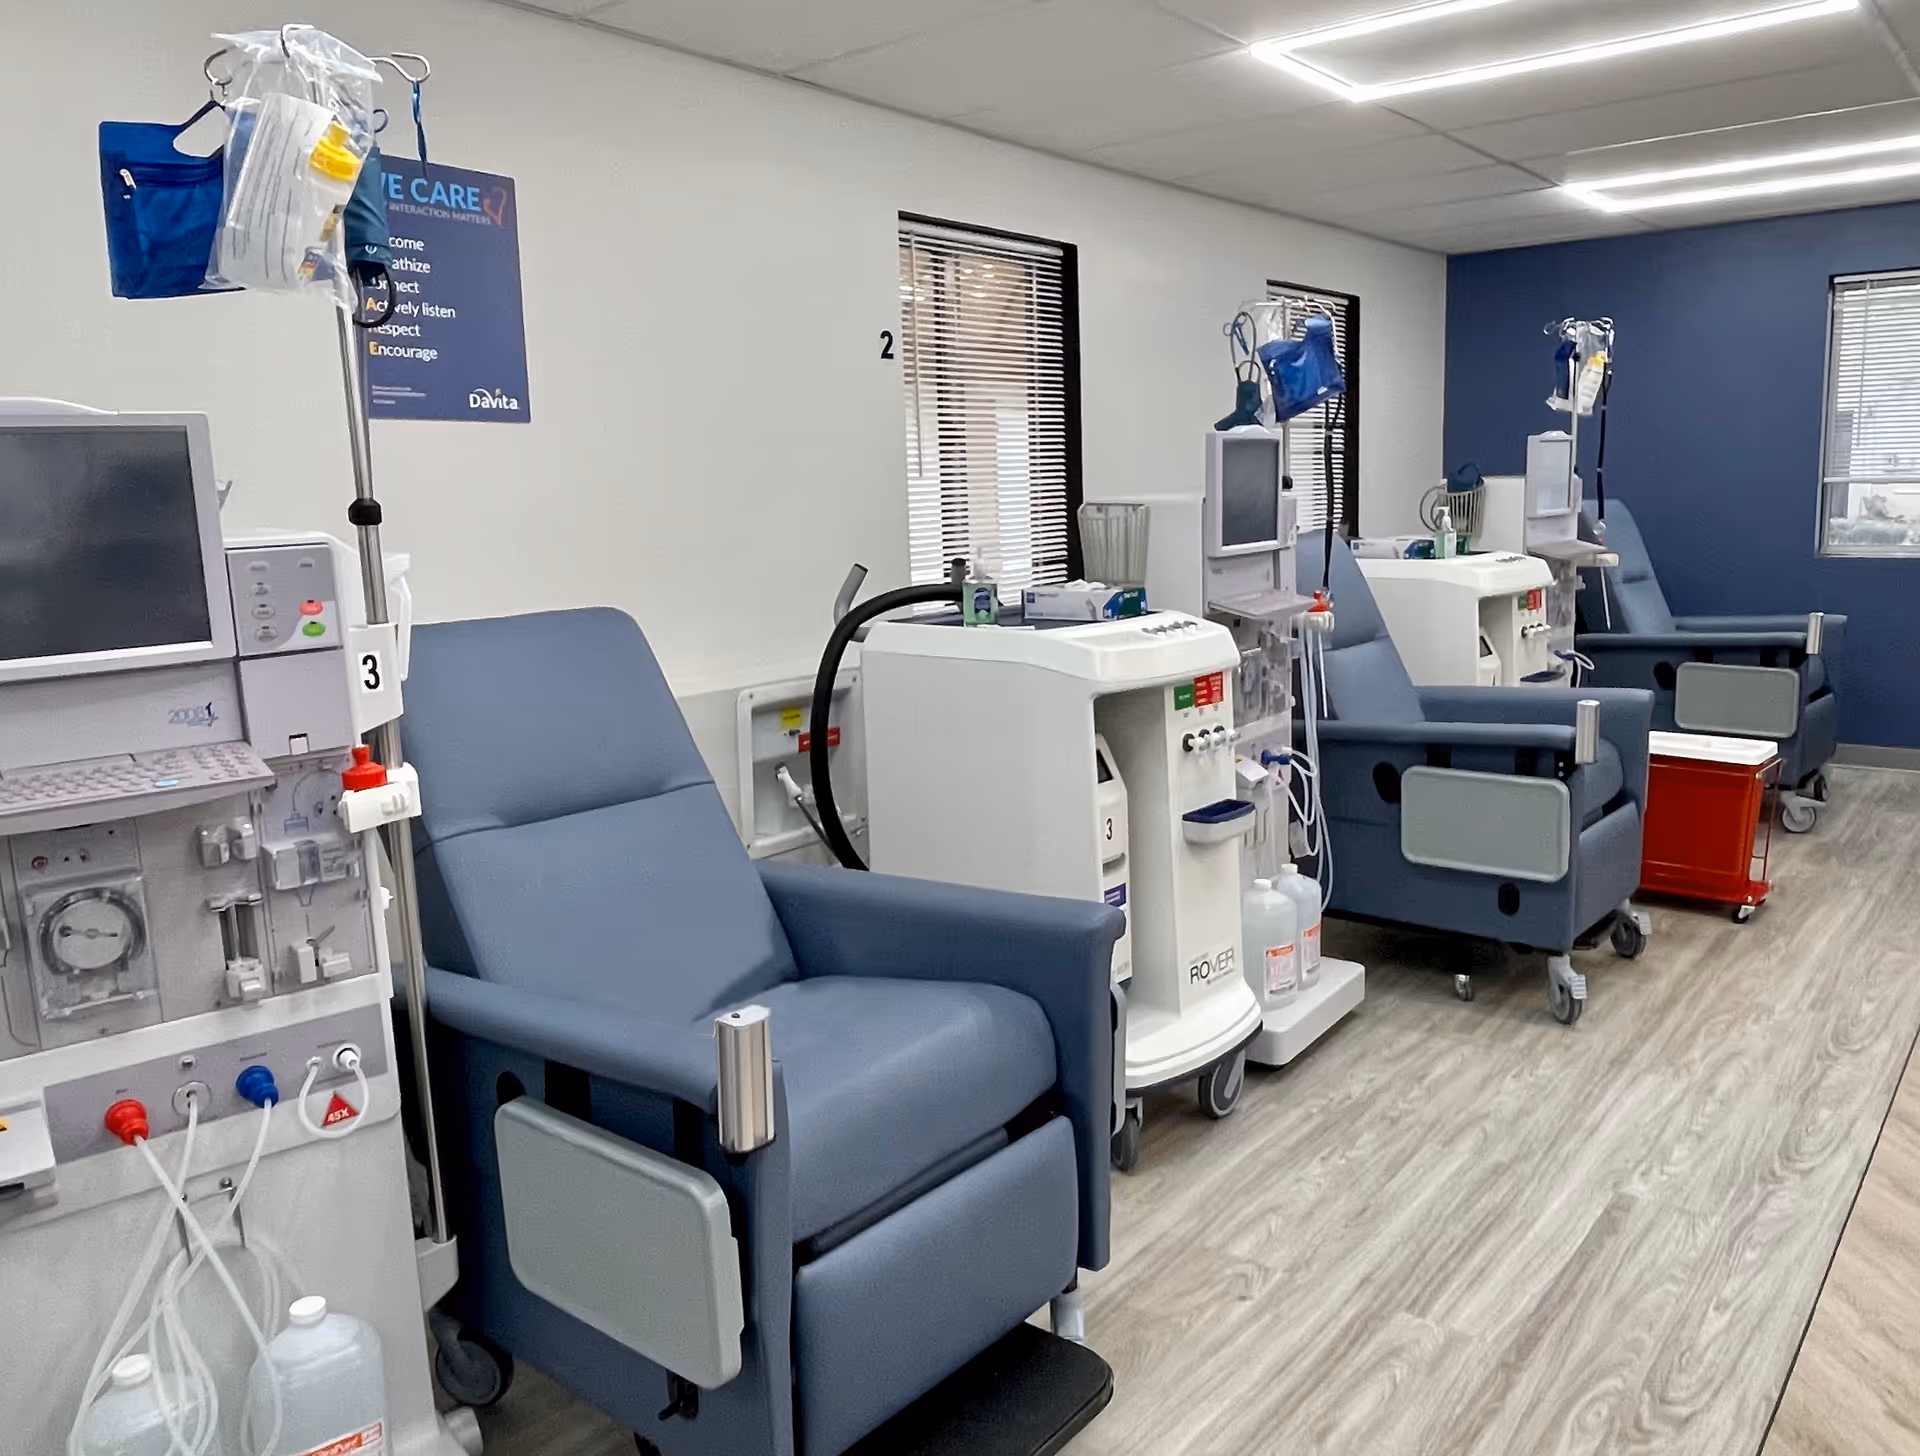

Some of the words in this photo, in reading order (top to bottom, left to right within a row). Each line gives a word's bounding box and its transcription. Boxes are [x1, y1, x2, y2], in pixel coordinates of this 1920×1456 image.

[381, 172, 404, 200] E
[410, 177, 482, 212] CARE
[388, 202, 451, 218] INTERACTION
[452, 210, 491, 226] MATTERS
[388, 236, 425, 252] come
[391, 256, 431, 274] athize
[365, 297, 420, 318] Actvely
[421, 302, 456, 319] listen
[369, 341, 438, 362] Encourage
[880, 330, 895, 360] 2
[362, 654, 380, 690] 3
[1106, 817, 1113, 841] 3
[1190, 946, 1235, 985] ROVER
